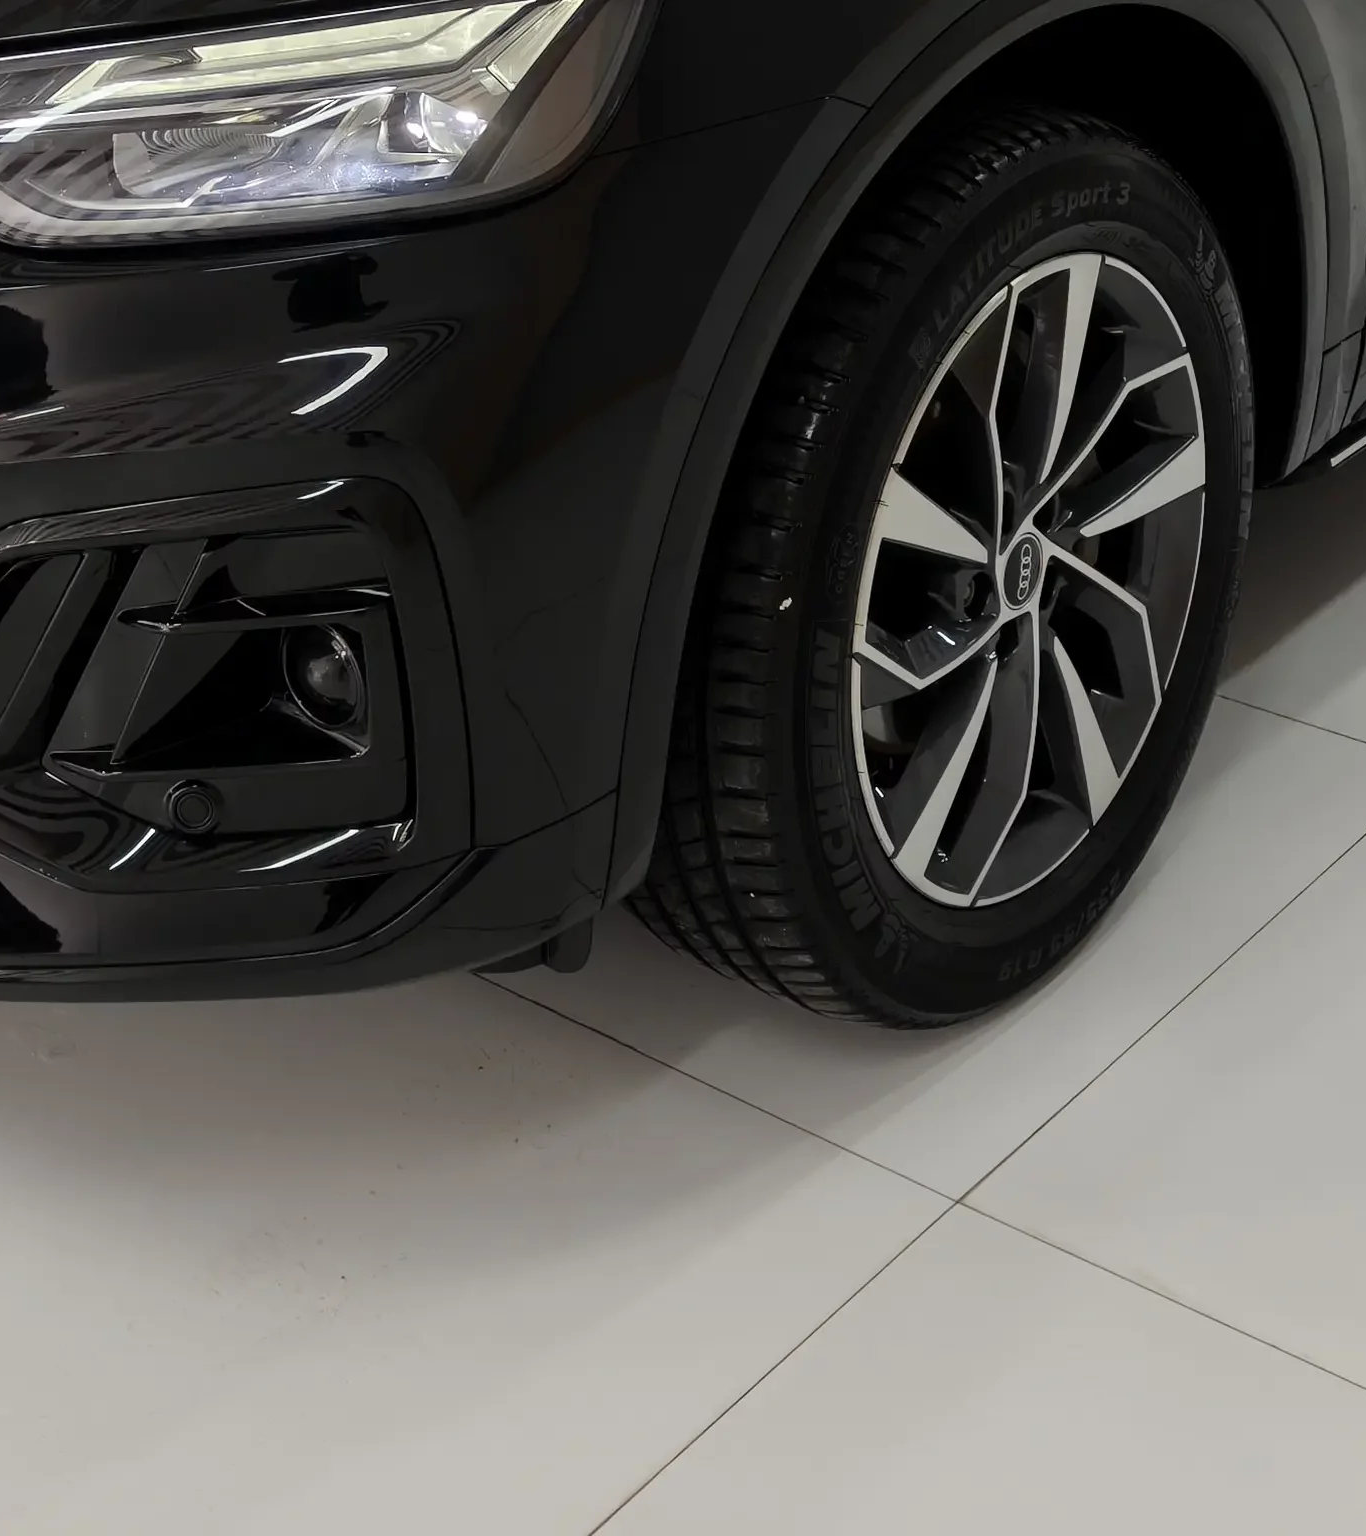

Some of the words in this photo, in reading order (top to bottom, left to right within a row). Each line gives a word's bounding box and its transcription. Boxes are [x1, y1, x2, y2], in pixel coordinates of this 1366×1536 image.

[1051, 180, 1112, 218] Sport
[1115, 181, 1132, 207] 3
[810, 628, 883, 932] MICHELIN
